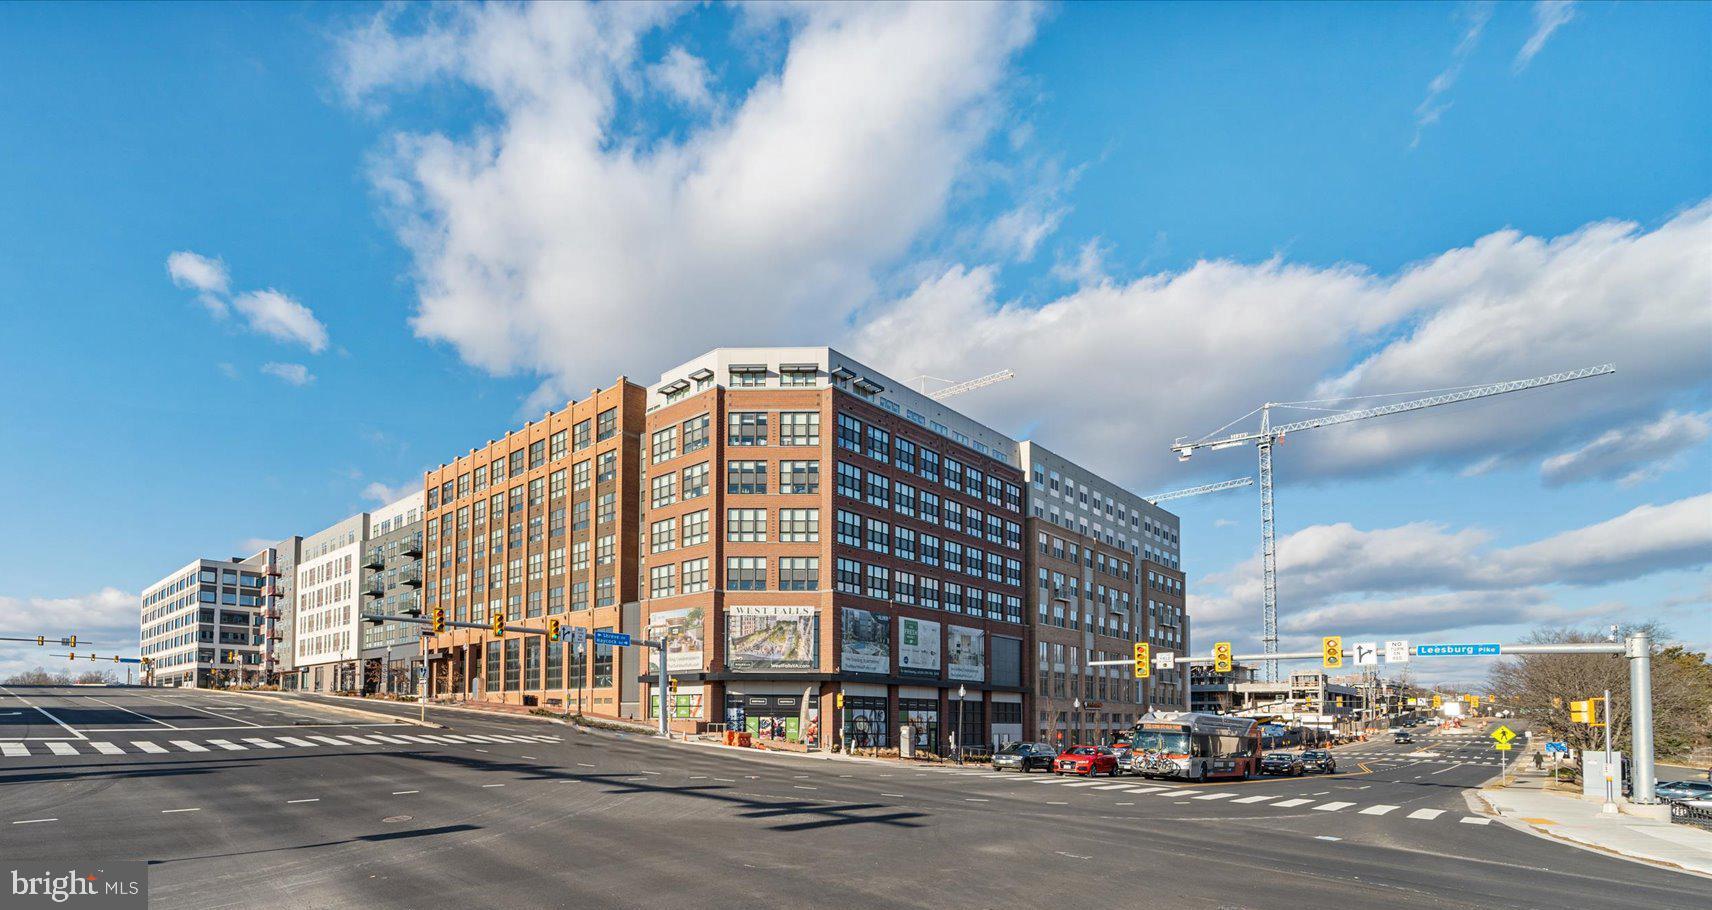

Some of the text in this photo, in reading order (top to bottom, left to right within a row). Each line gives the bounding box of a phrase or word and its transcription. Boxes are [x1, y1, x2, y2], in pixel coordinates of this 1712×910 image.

[736, 607, 809, 615] WEST FALLS
[1421, 646, 1474, 655] Leesburg
